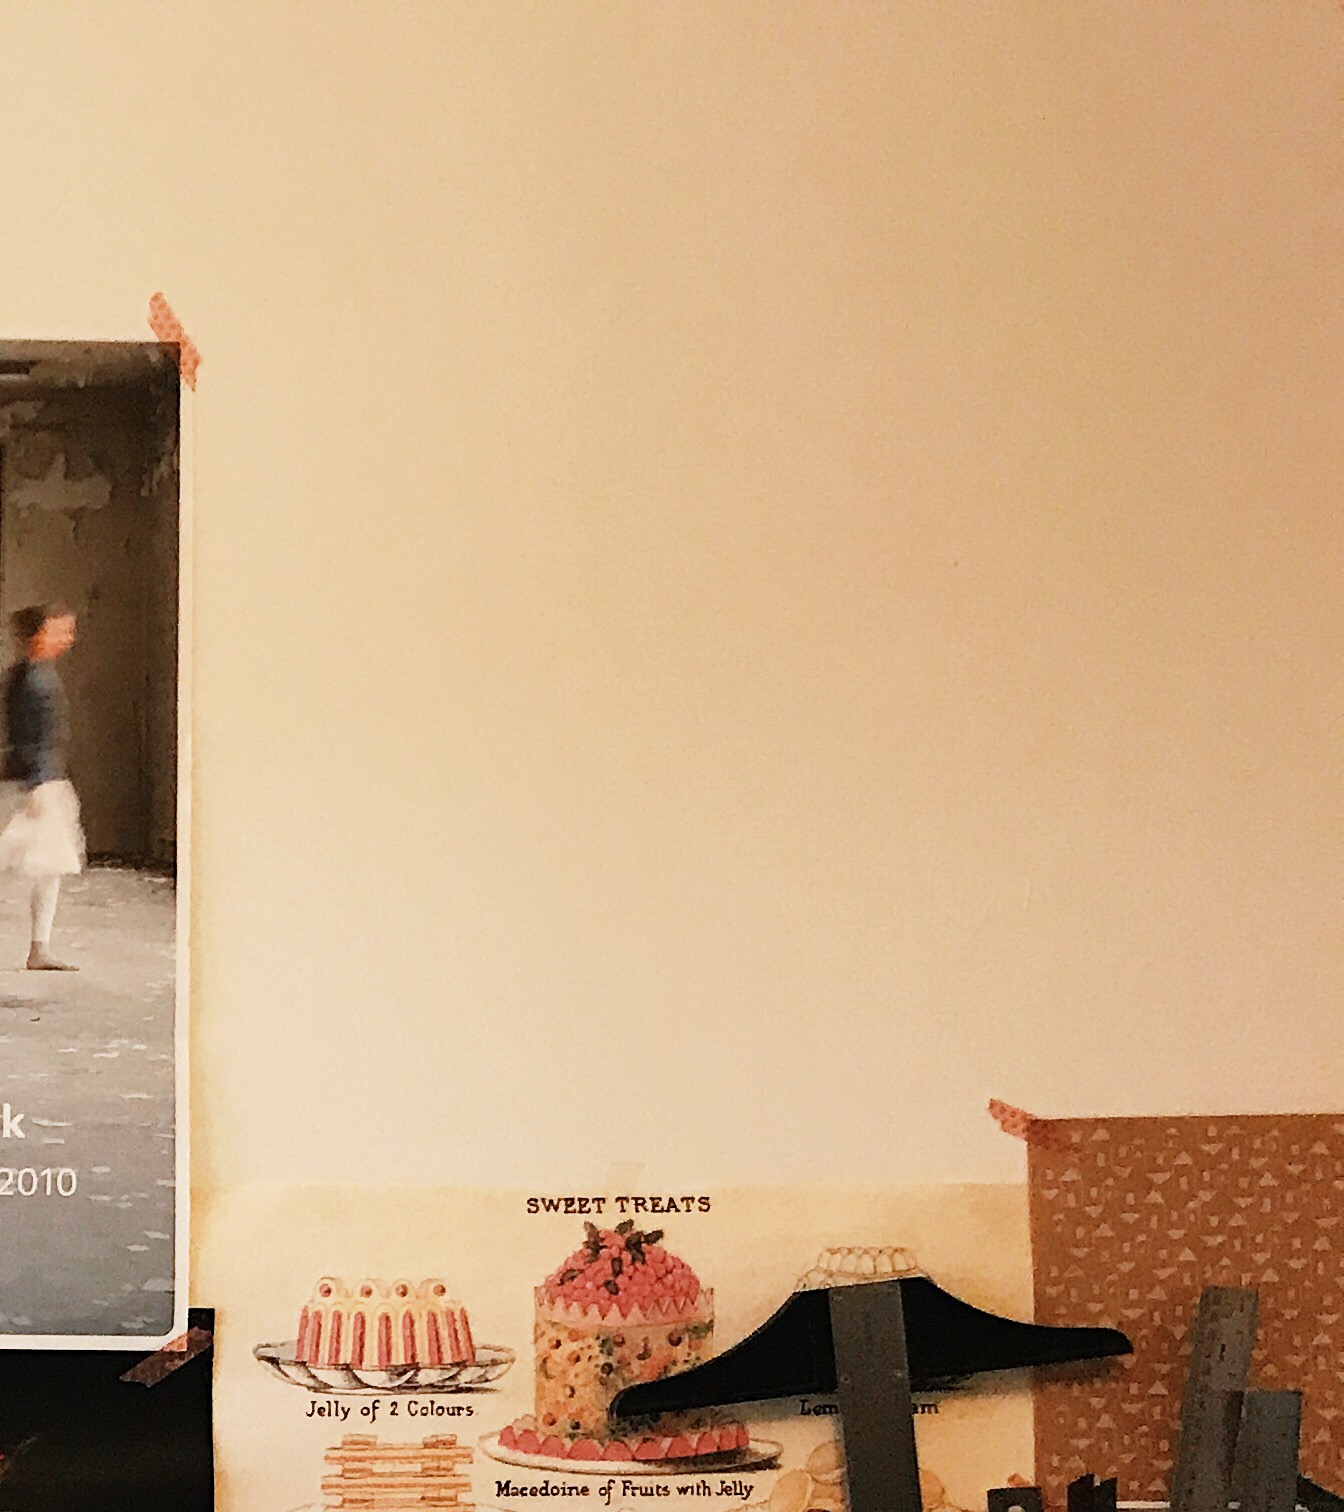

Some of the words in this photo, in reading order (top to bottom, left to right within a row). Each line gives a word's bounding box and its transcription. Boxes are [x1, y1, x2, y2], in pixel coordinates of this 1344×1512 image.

[527, 1198, 606, 1214] SWEET
[615, 1196, 710, 1213] TREATS
[306, 1401, 350, 1421] Jelly
[361, 1400, 380, 1423] of
[390, 1401, 398, 1416] 2
[495, 1480, 589, 1497] Macedoine
[599, 1479, 615, 1505] of
[622, 1480, 670, 1496] Fruits
[676, 1480, 711, 1496] with
[715, 1481, 754, 1500] Jelly
